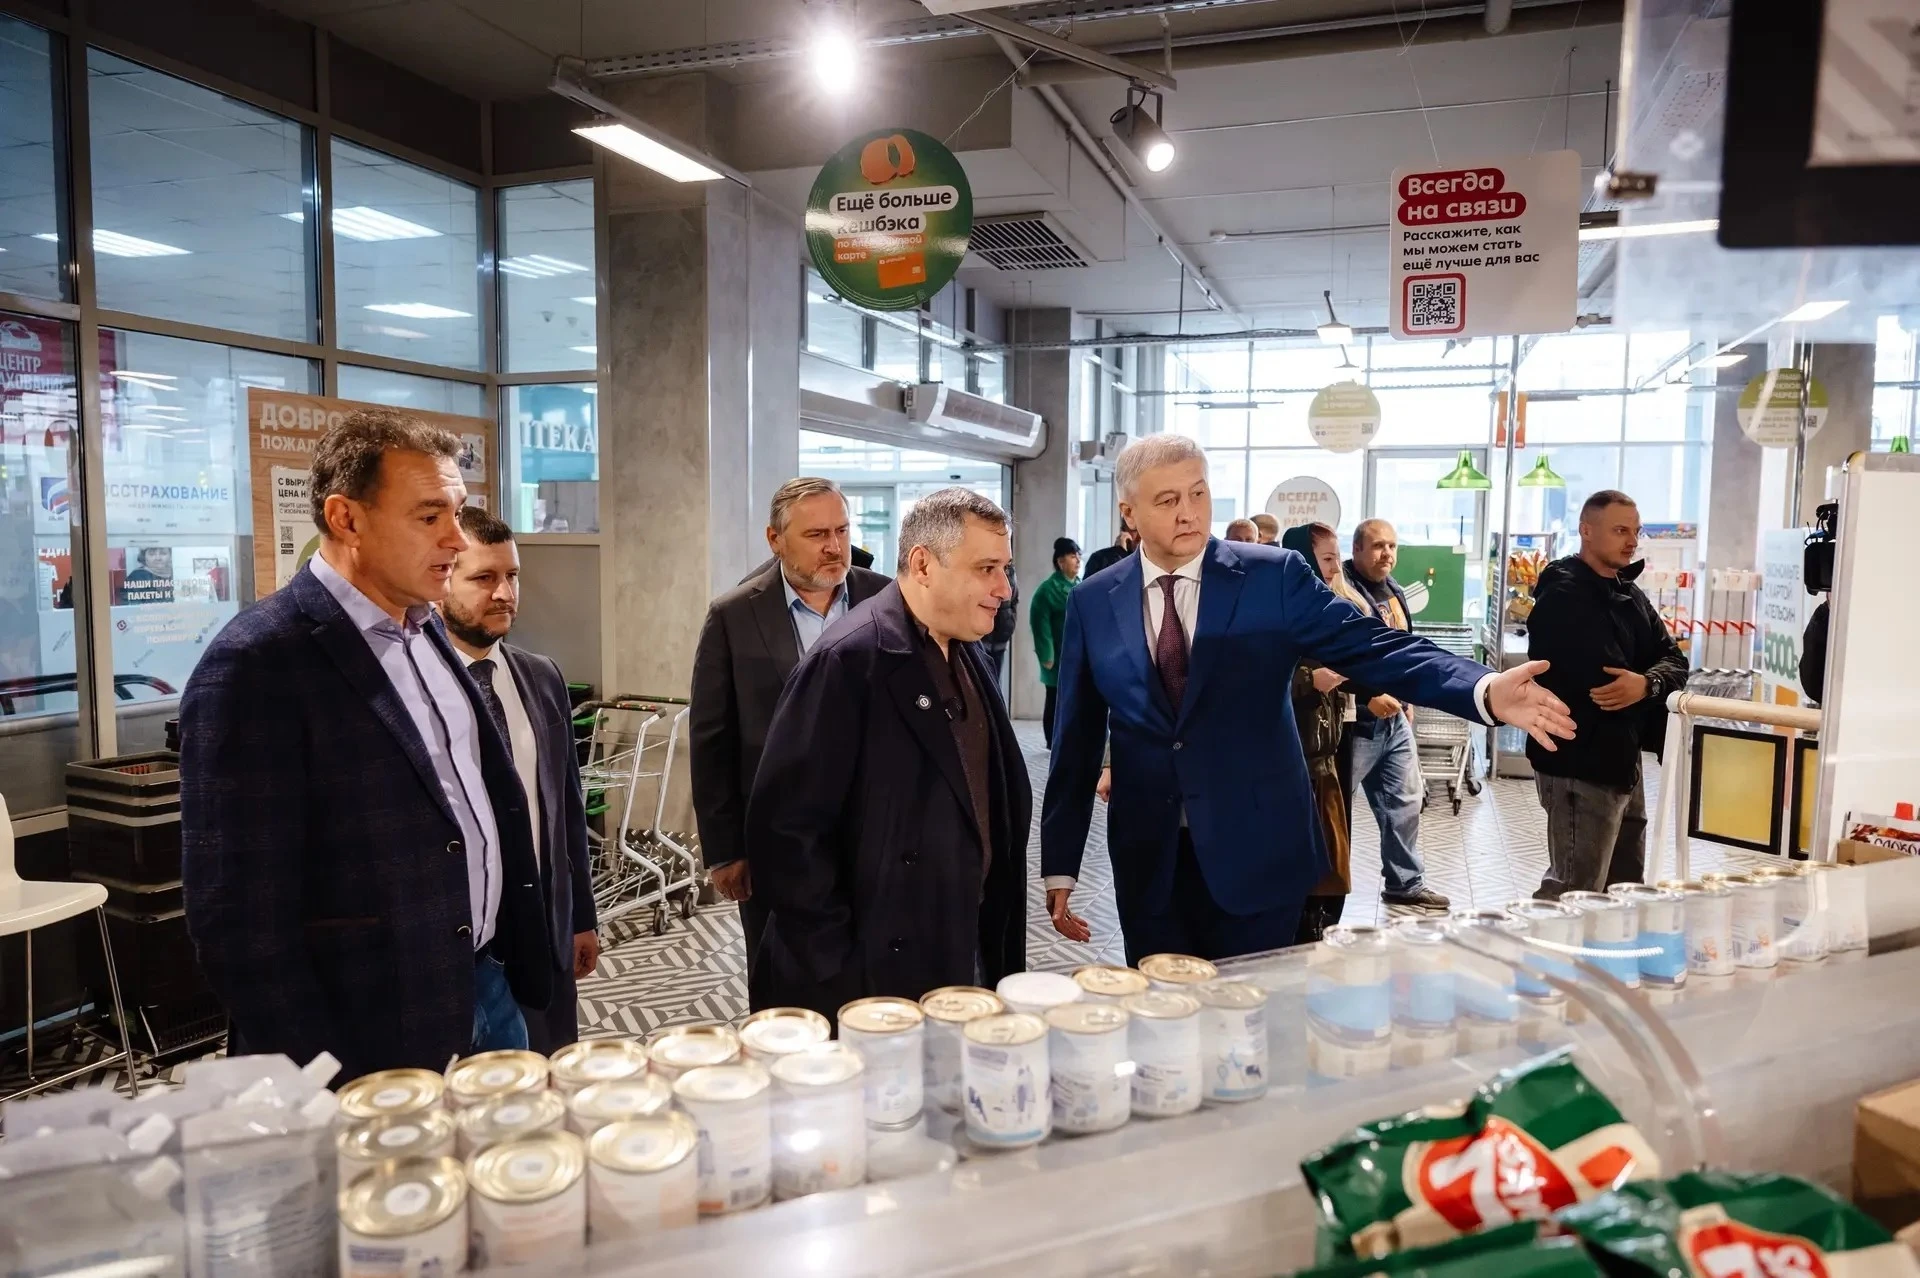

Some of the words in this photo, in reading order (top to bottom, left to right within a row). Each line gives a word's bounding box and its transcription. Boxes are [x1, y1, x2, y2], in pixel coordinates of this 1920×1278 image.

[1407, 172, 1495, 196] Всегда
[837, 193, 874, 213] Ещё
[879, 191, 952, 210] больше
[1407, 203, 1439, 221] на
[1445, 198, 1516, 218] связи
[837, 215, 920, 235] кешбэка
[1403, 226, 1492, 242] Расскажите,
[1495, 224, 1521, 236] как
[837, 240, 849, 249] по
[1403, 246, 1425, 256] мы
[1428, 242, 1479, 255] можем
[1482, 239, 1522, 251] стать
[837, 251, 867, 262] карте
[1402, 258, 1432, 271] ещё
[1435, 255, 1482, 270] лучше
[1485, 254, 1511, 267] для
[1515, 253, 1540, 264] вас
[260, 434, 317, 453] ПОЖАЛ
[278, 477, 284, 486] С
[286, 478, 309, 487] ВЫРУ
[278, 489, 300, 498] ЦЕНА
[1278, 491, 1329, 503] ВСЕГДА
[1288, 504, 1317, 515] ВАМ
[124, 580, 151, 589] НАШИ
[127, 591, 163, 600] ПАКЕТЫ
